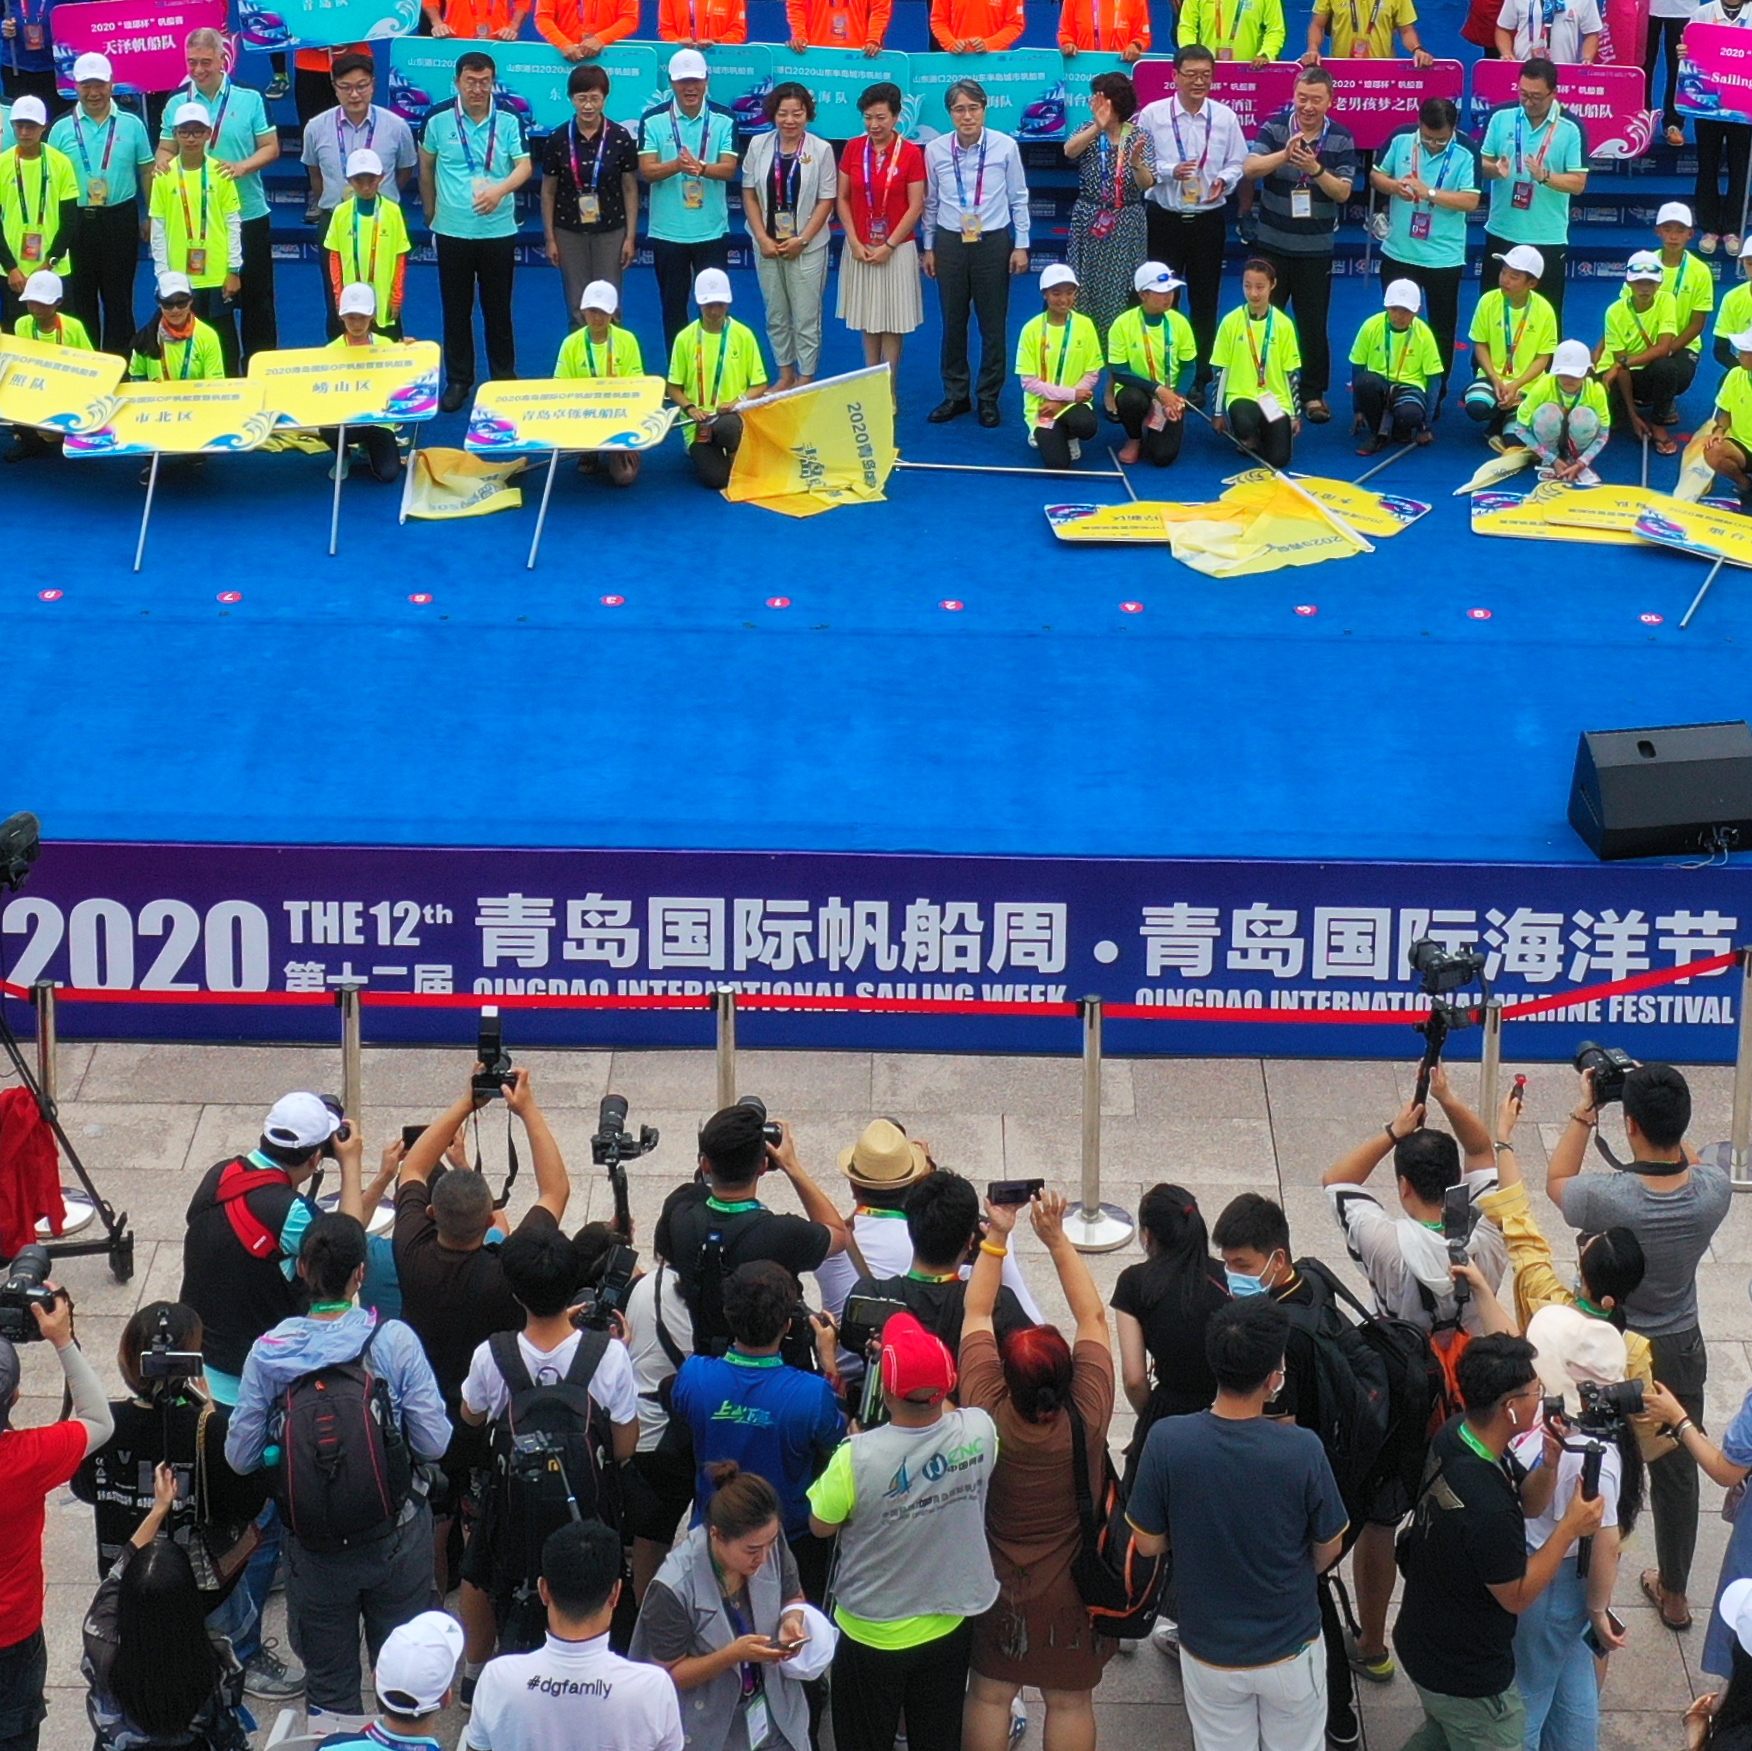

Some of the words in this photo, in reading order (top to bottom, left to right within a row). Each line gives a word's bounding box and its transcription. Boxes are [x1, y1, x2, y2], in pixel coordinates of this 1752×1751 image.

[102, 34, 177, 56] 天泽帆船队
[312, 379, 372, 395] 崂山区
[134, 410, 194, 425] 市北区
[283, 900, 363, 944] THE
[370, 901, 453, 946] 12th
[3, 897, 270, 994] 2020
[1609, 993, 1735, 1025] FESTIVAL
[527, 1674, 614, 1700] #dgfamily
